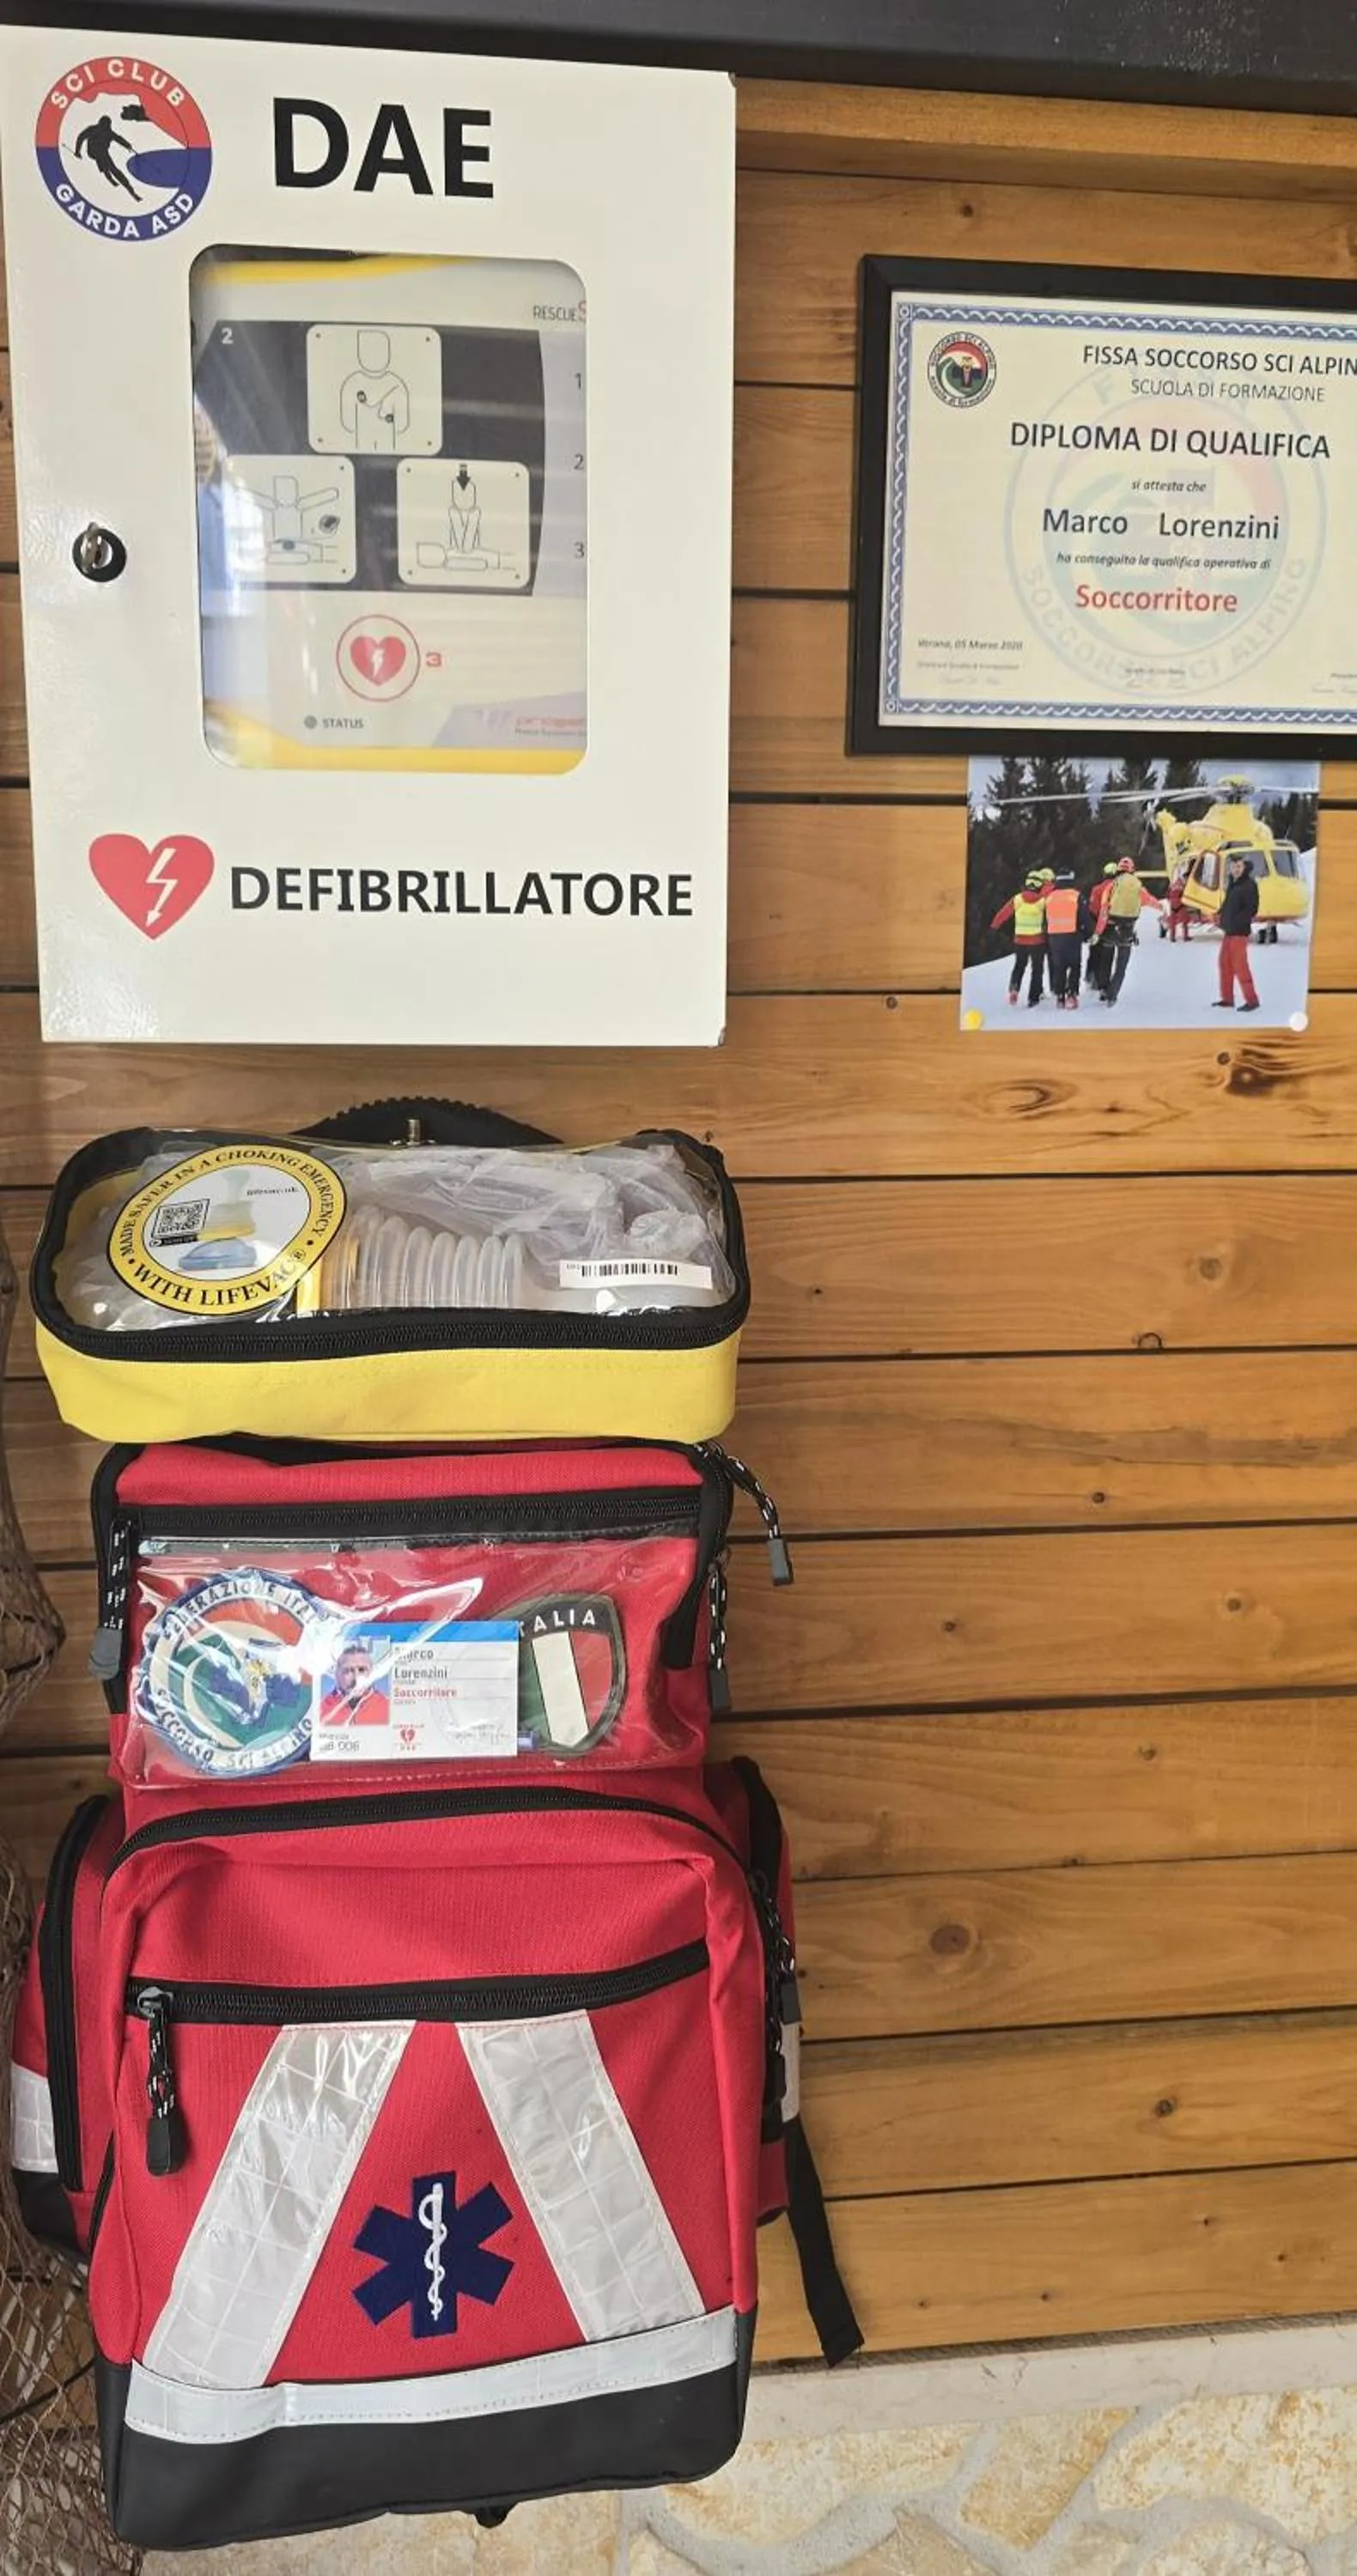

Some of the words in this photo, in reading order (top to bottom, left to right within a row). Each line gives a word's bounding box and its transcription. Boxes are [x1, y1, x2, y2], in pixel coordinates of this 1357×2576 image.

[51, 64, 95, 110] SCI
[107, 59, 185, 107] CLUB
[272, 96, 495, 199] DAE
[55, 183, 139, 239] GARDA
[151, 191, 195, 236] ASD
[222, 328, 234, 344] 2
[1082, 344, 1138, 366] FISSA
[1144, 348, 1258, 372] SOCCORSO
[1264, 354, 1293, 374] SCI
[575, 373, 582, 390] 1
[1130, 378, 1193, 398] SCUOLA
[1198, 383, 1214, 398] DI
[1219, 383, 1326, 403] FORMAZIONE
[1010, 422, 1141, 451] DIPLOMA
[1150, 428, 1177, 452] DI
[1186, 429, 1330, 459] QUALIFICA
[574, 454, 584, 470] 2
[1130, 478, 1141, 491] si
[1143, 479, 1184, 492] attesta
[1186, 480, 1207, 492] che
[1042, 508, 1129, 534] Marco
[1159, 513, 1280, 540] Lorenzini
[574, 541, 585, 558] 3
[1056, 552, 1071, 564] ha
[1074, 555, 1136, 568] conseguito
[1139, 555, 1149, 565] la
[1152, 556, 1200, 569] qualifica
[1203, 558, 1257, 569] operativa
[1260, 558, 1271, 569] di
[1074, 585, 1238, 612] Soccorritore
[322, 716, 364, 729] STATUS
[230, 866, 694, 917] DEFIBRILLATORE
[174, 1167, 196, 1182] IN
[199, 1159, 212, 1171] A
[215, 1149, 300, 1168] CHOKING
[299, 1162, 334, 1237] EMERGENCY
[133, 1262, 191, 1304] WITH
[519, 1608, 596, 1637] TALIA
[394, 1666, 448, 1680] Lorenzini
